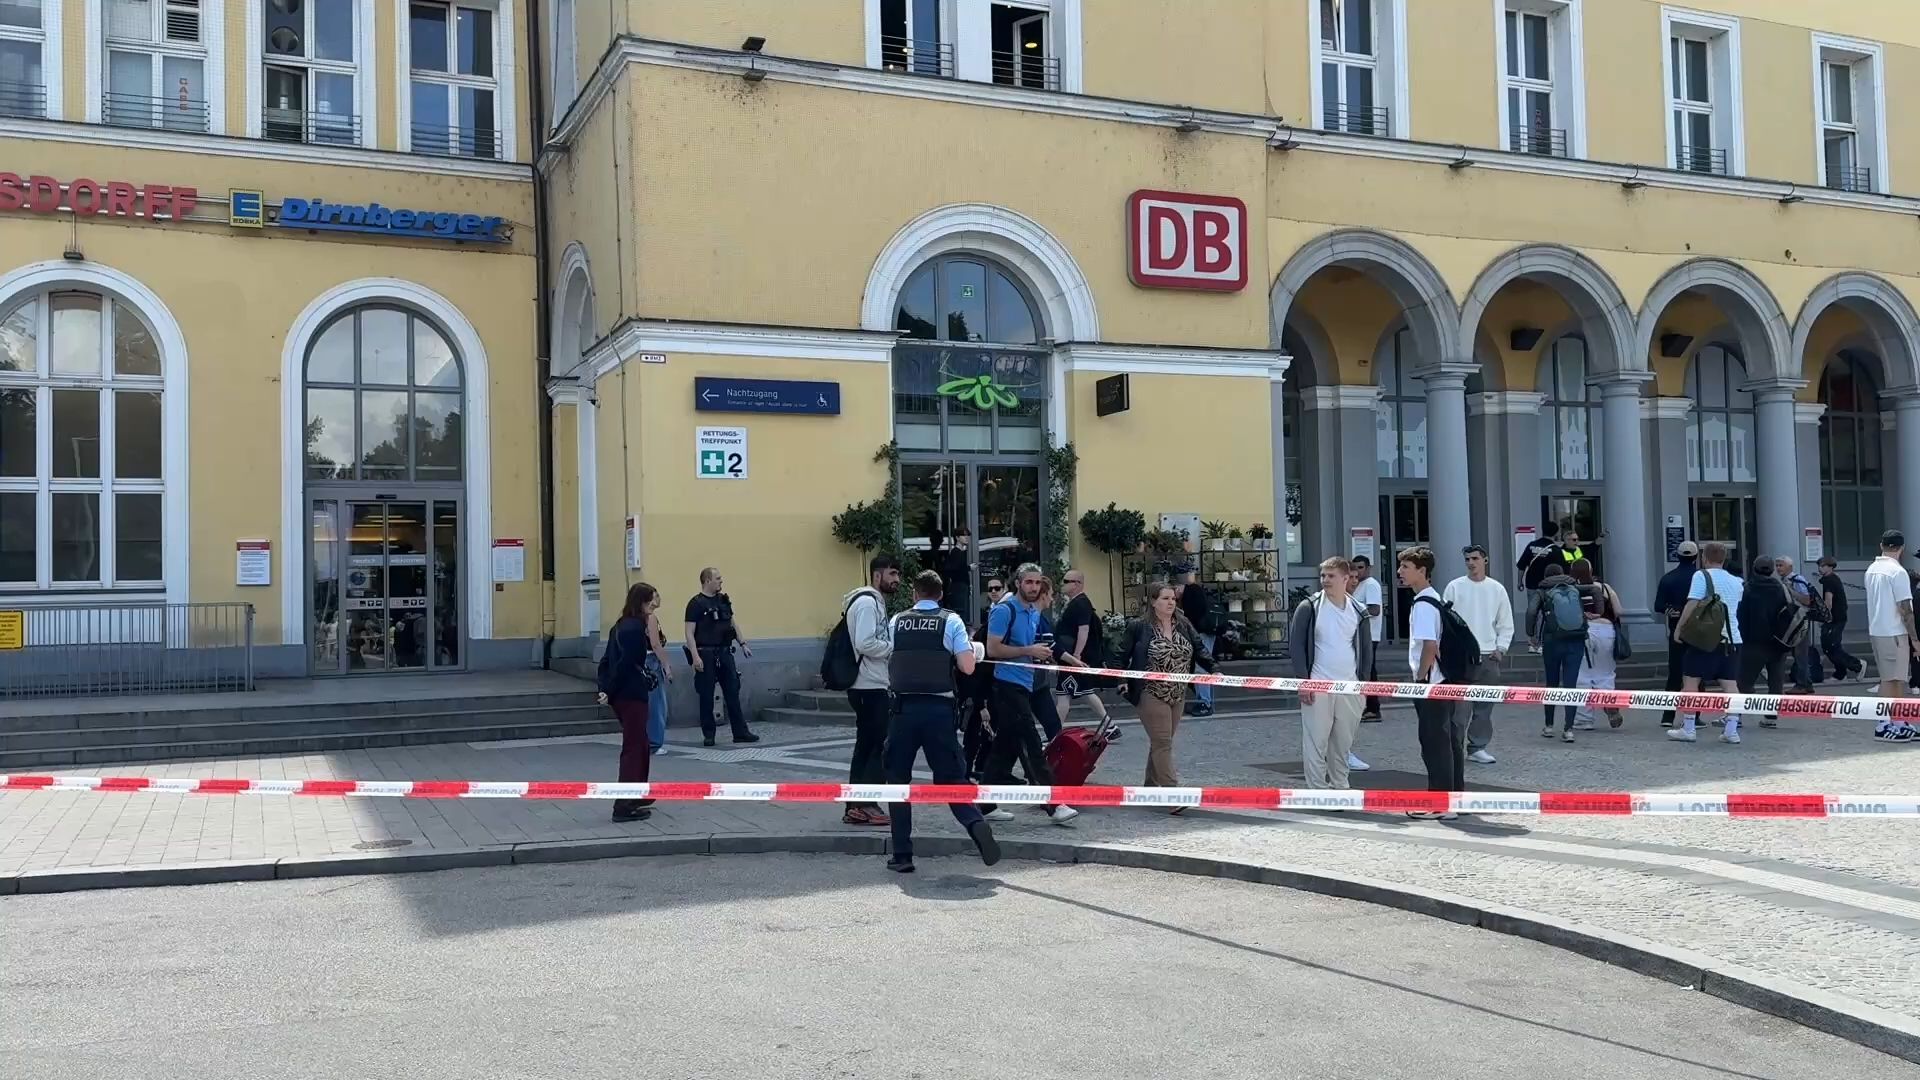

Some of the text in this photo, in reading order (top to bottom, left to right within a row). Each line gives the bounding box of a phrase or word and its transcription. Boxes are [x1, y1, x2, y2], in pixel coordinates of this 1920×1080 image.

[233, 193, 259, 217] E
[280, 198, 507, 236] Dirnberger
[1148, 205, 1233, 274] DB
[726, 388, 779, 399] Nachtzugang
[728, 452, 743, 473] 2
[897, 618, 940, 631] POLIZEI
[1432, 686, 1517, 700] POLIZEIABSPERRUNG
[1526, 690, 1617, 705] POLIZEIABSPERRUNG
[1628, 693, 1731, 710] POLIZEIABSPERRUNG
[1743, 697, 1860, 715] POLIZEIABSPERRUNG
